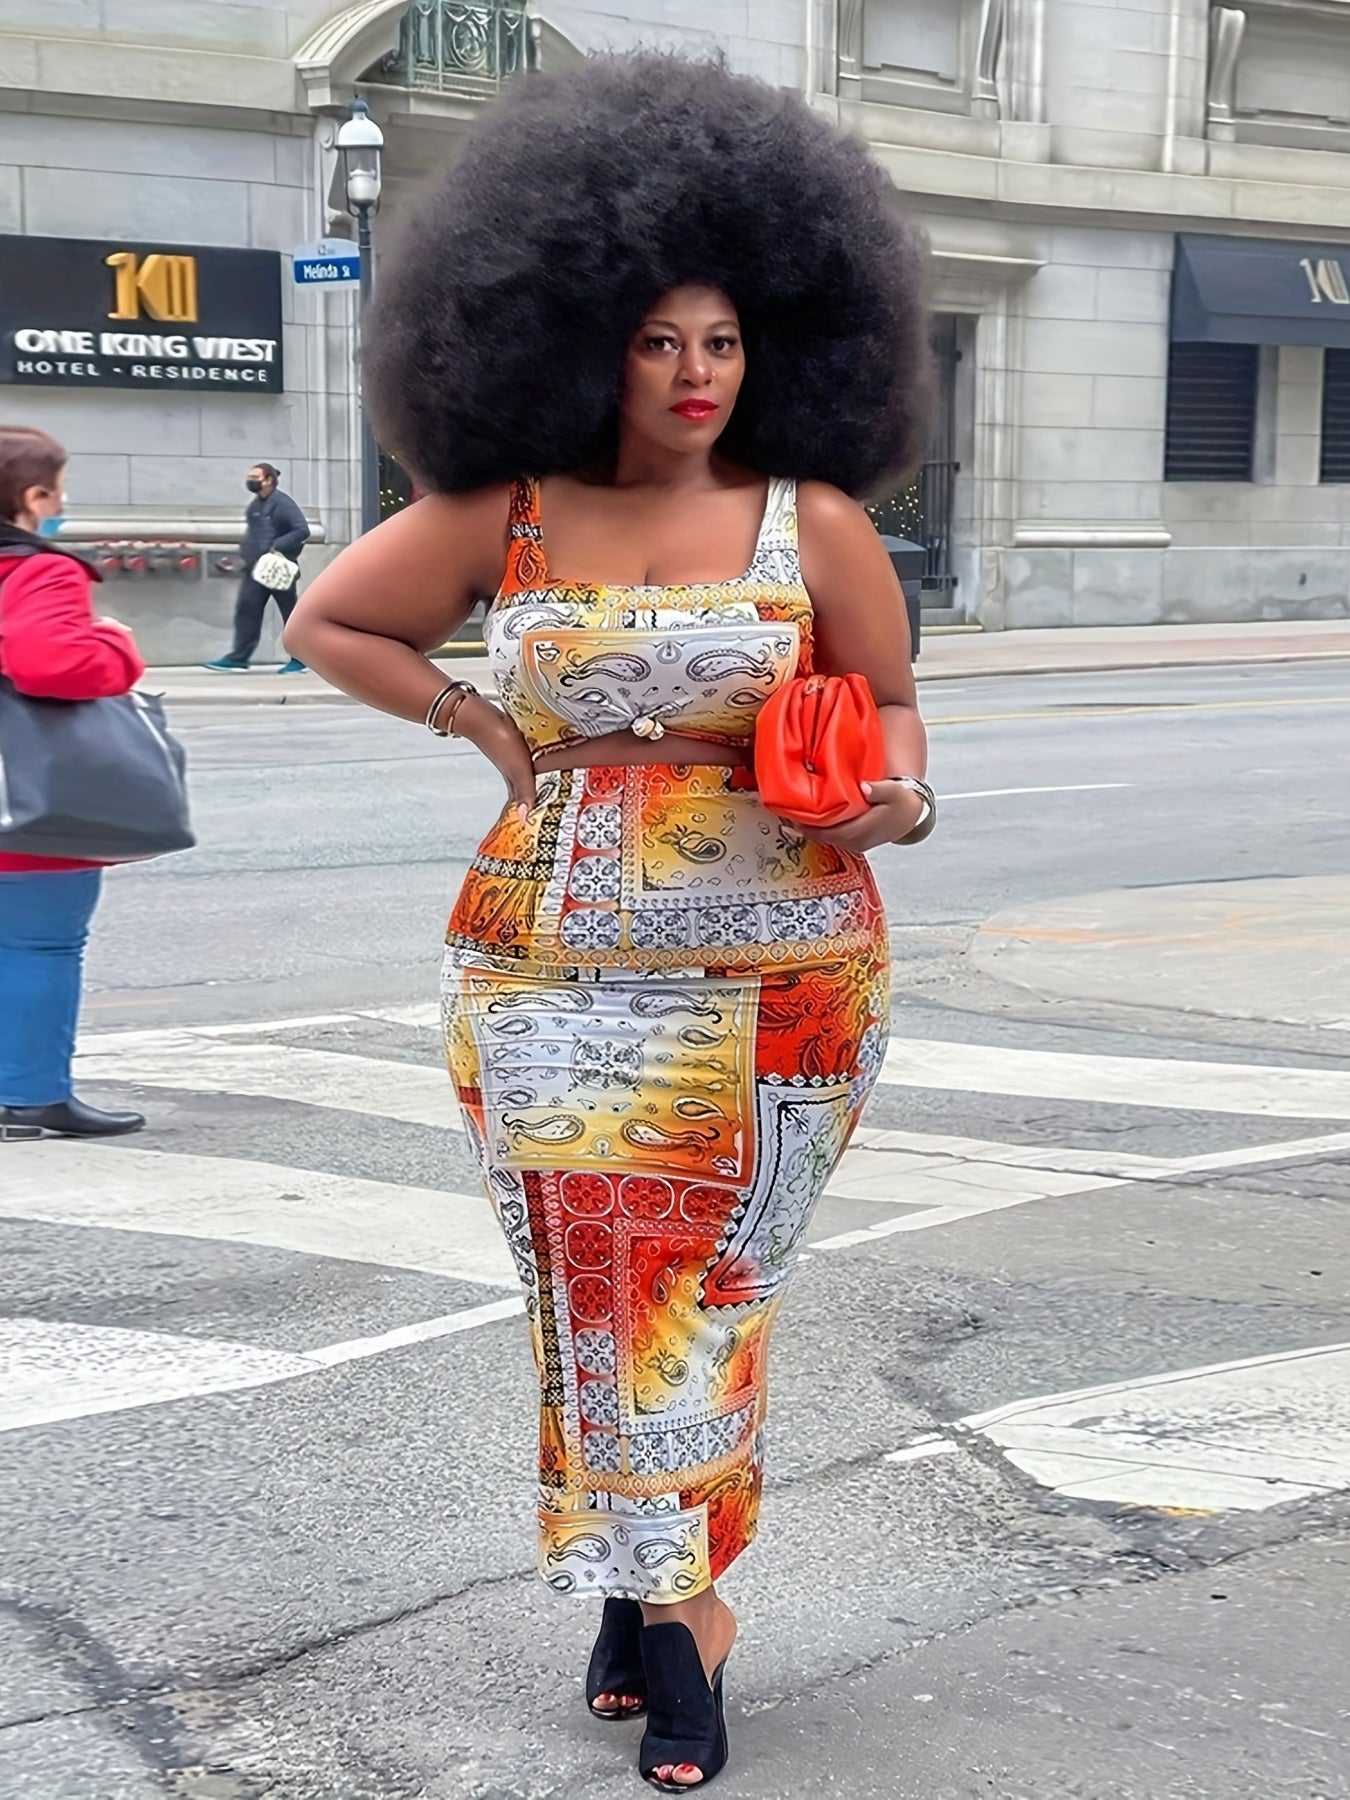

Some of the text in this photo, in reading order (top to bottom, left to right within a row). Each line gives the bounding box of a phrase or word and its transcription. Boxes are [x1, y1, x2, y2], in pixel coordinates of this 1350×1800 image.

[15, 329, 277, 362] ONE KING WEST
[17, 360, 100, 376] HOTEL
[131, 364, 267, 382] RESIDENCE
